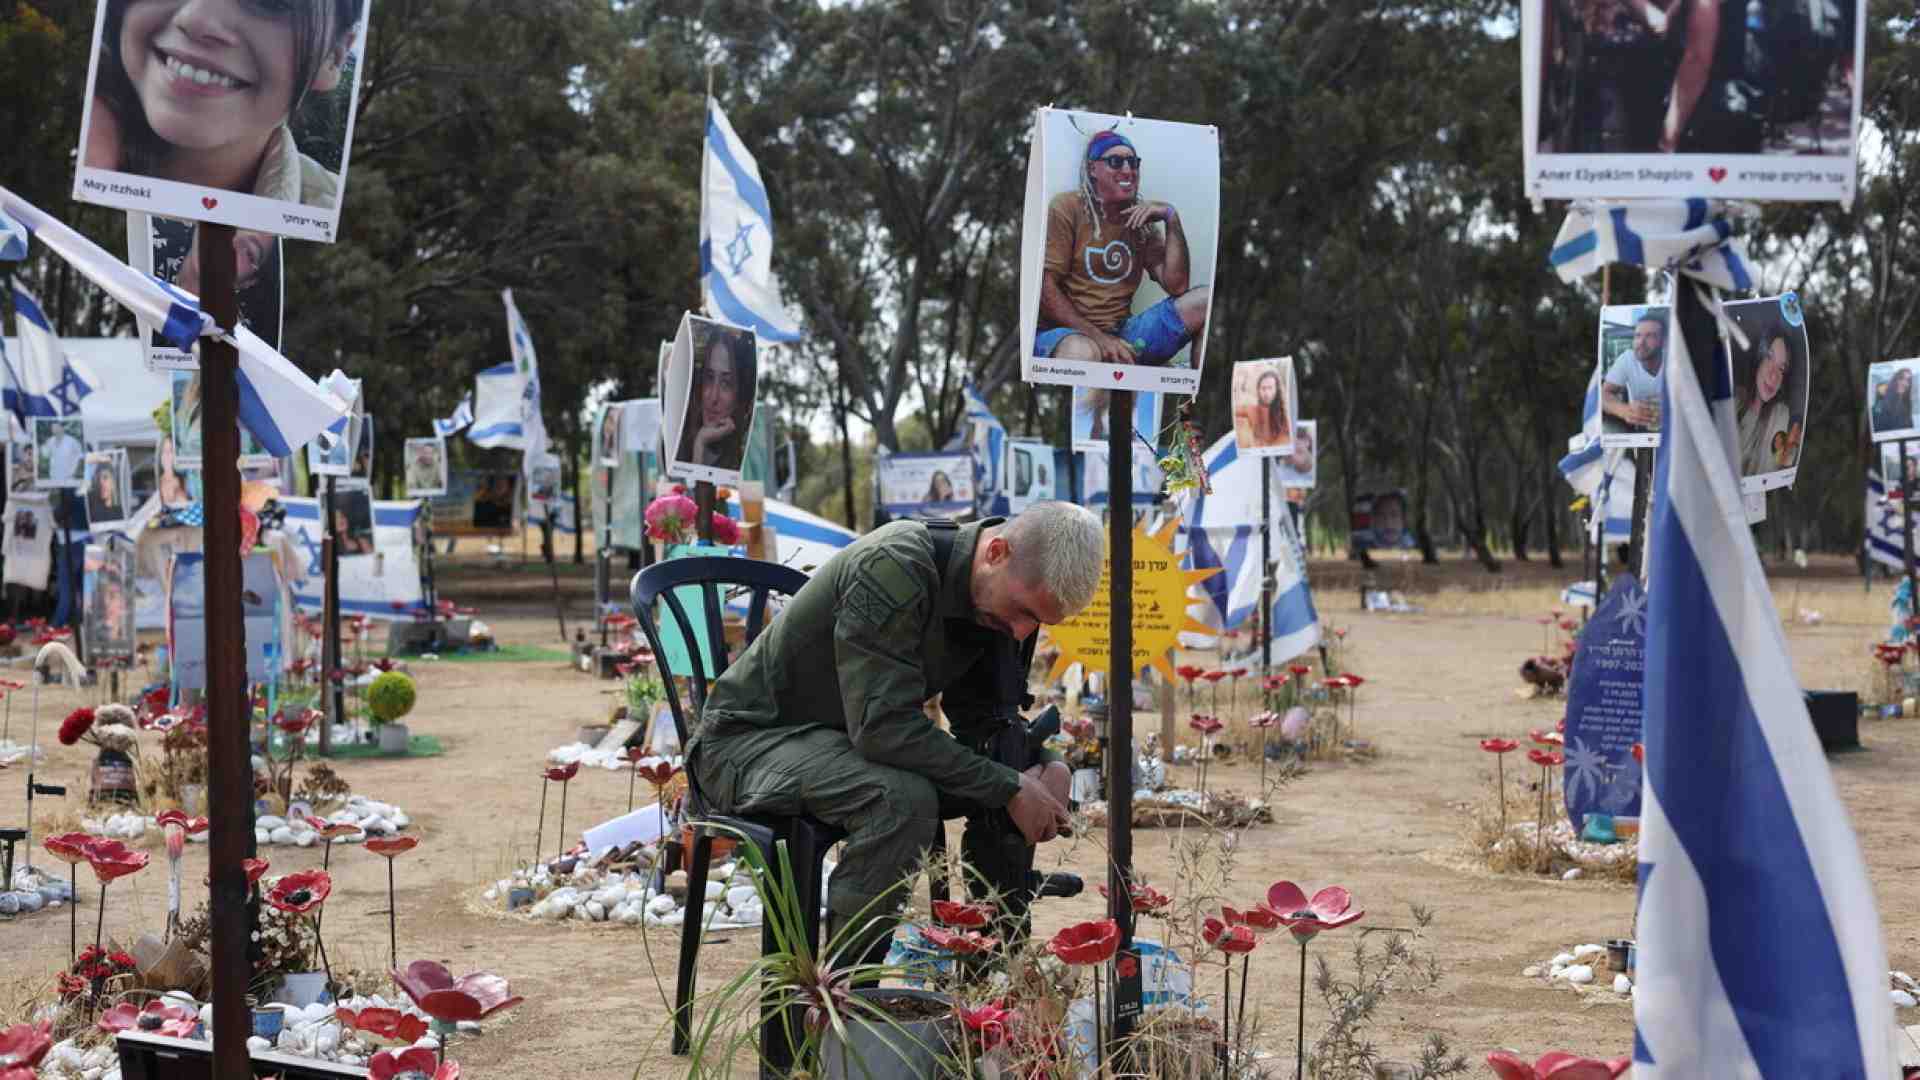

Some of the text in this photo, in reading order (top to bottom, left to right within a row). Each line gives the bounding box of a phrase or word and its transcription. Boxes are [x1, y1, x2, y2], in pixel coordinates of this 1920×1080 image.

[1538, 168, 1572, 181] Aner
[1575, 168, 1635, 183] Elyakim
[83, 179, 152, 199] May Itzhaki
[1594, 657, 1645, 673] 1997-202
